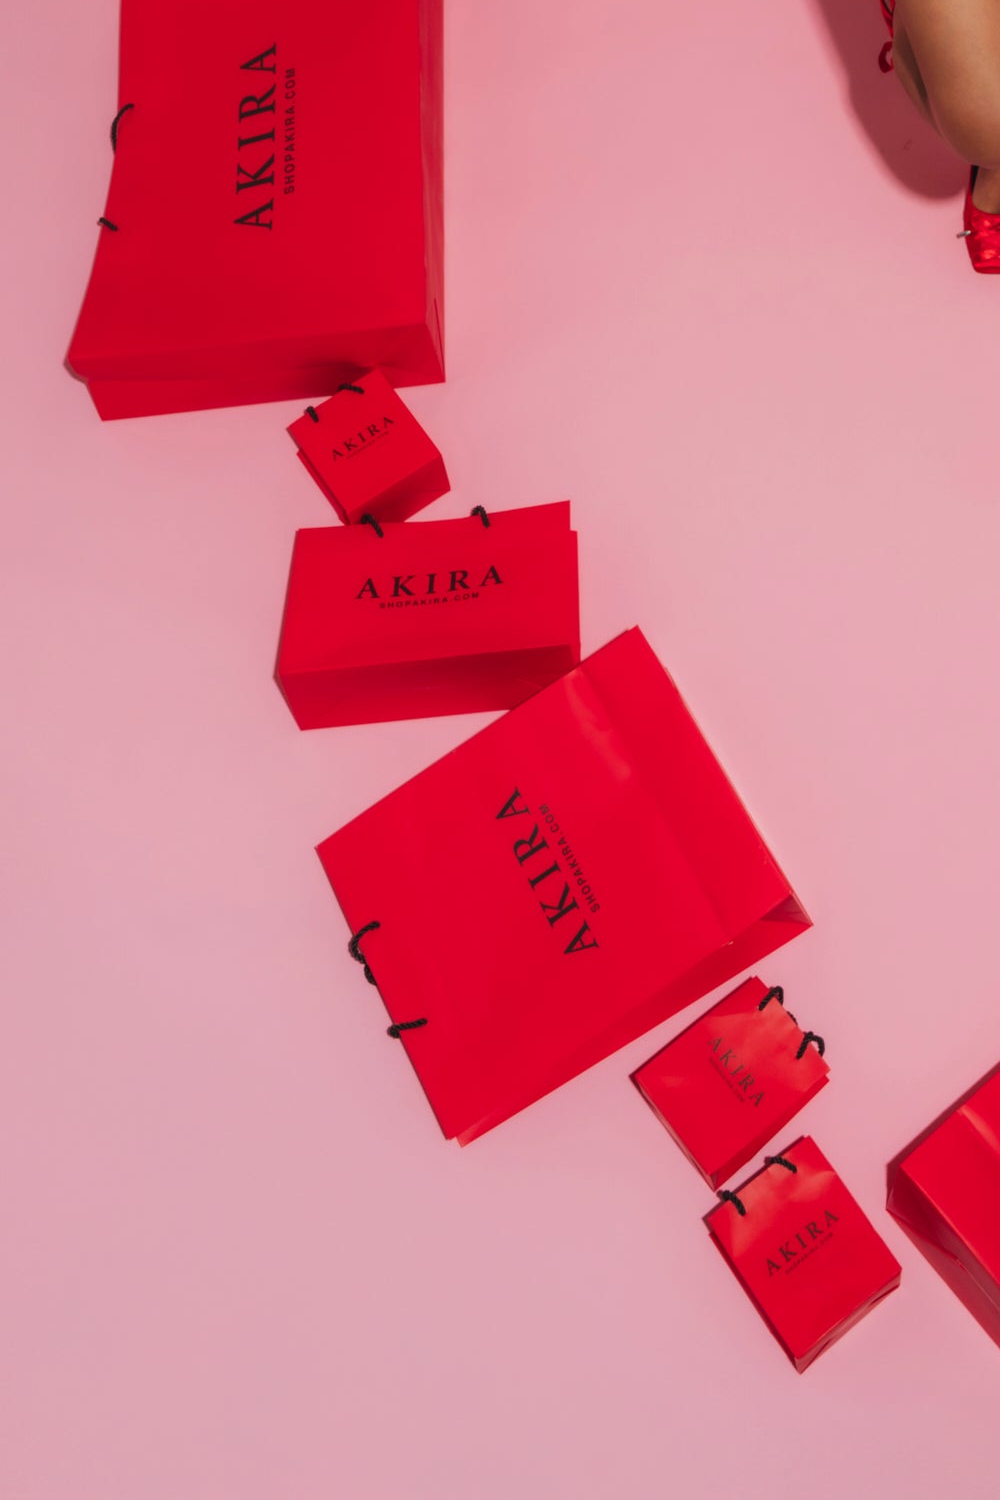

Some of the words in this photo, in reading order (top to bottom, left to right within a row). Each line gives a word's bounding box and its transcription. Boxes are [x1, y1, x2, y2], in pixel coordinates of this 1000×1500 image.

[234, 43, 276, 230] AKIRA
[283, 67, 297, 195] SHOPAKIRA.COM
[332, 417, 393, 459] AKIRA
[357, 565, 503, 599] AKIRA
[495, 788, 599, 954] AKIRA
[538, 803, 600, 913] SHOPAKIRA.COM
[709, 1038, 764, 1106] AKIRA
[766, 1211, 838, 1275] AKIRA
